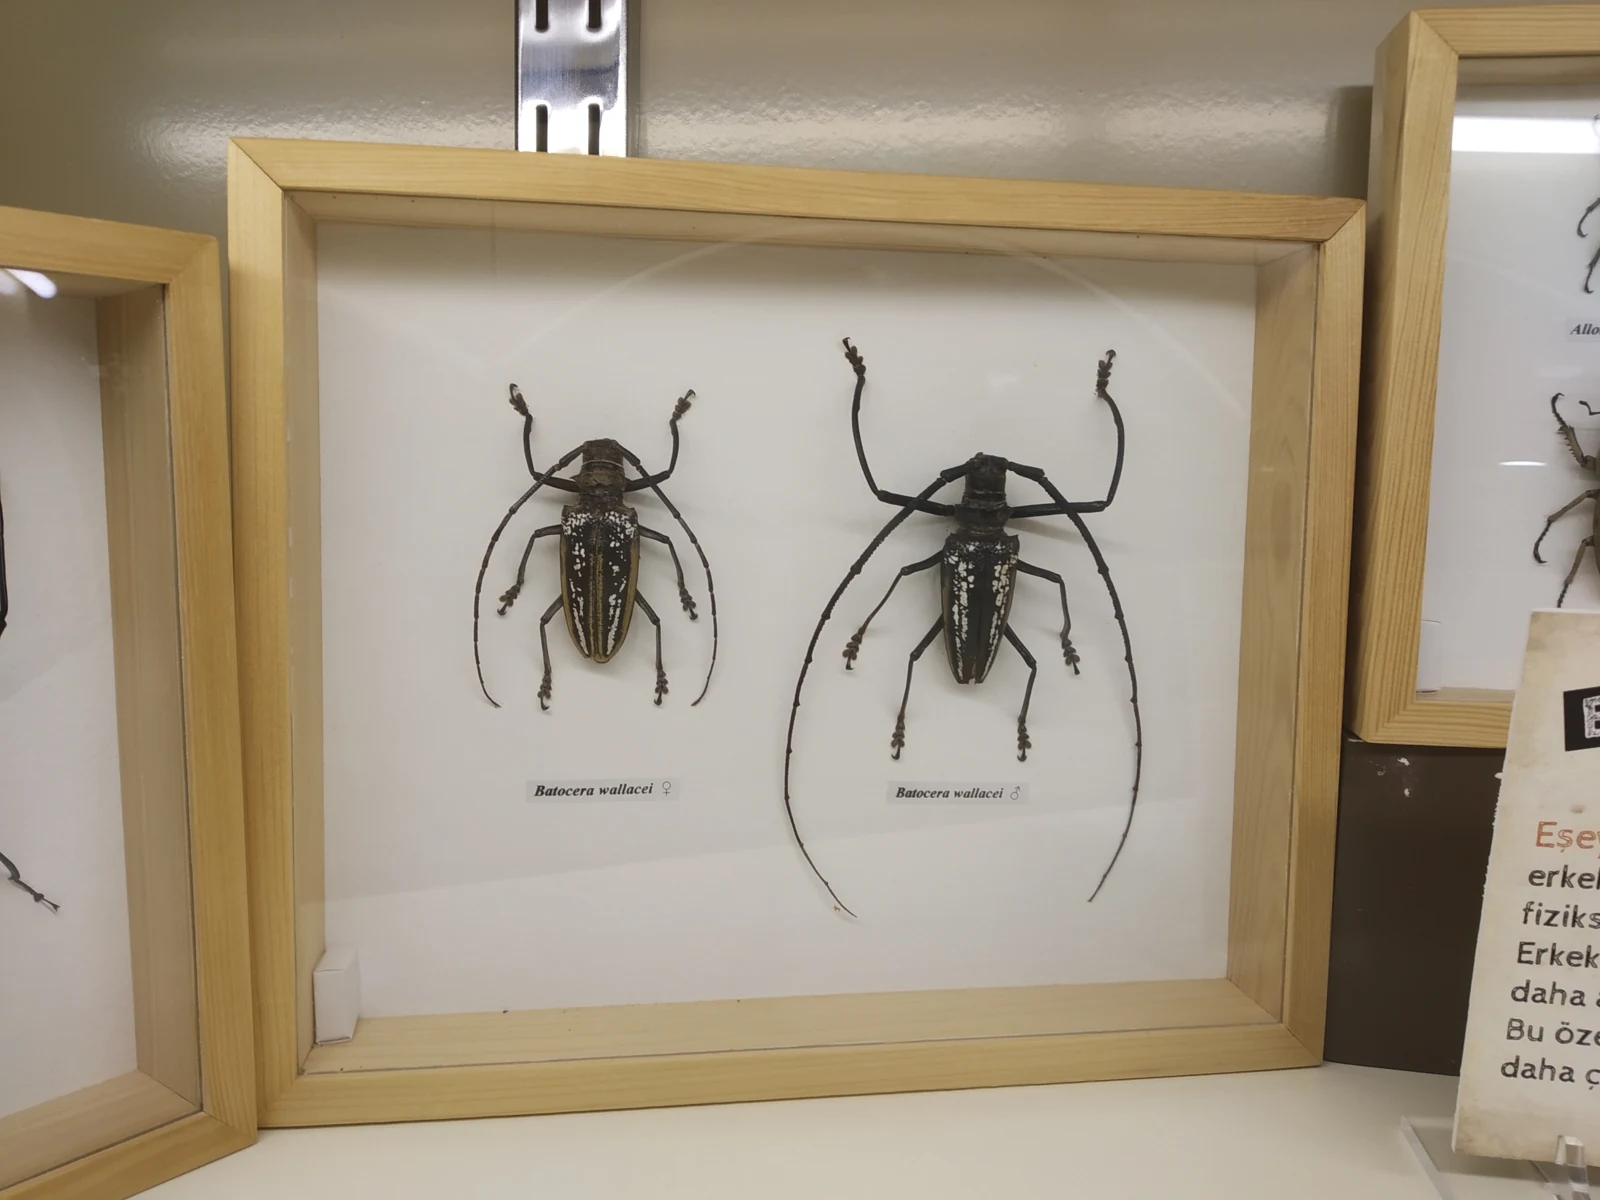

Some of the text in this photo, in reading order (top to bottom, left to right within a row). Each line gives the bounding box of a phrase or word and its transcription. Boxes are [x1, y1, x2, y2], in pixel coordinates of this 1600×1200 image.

[1569, 323, 1600, 336] Allo
[534, 782, 654, 797] Batocera wallacei
[896, 786, 1004, 799] Batocera wallacei
[1536, 821, 1600, 859] Eşe
[1528, 864, 1600, 890] erke
[1510, 979, 1586, 1007] daha
[1506, 1018, 1544, 1042] Bu
[1500, 1055, 1576, 1083] daha
